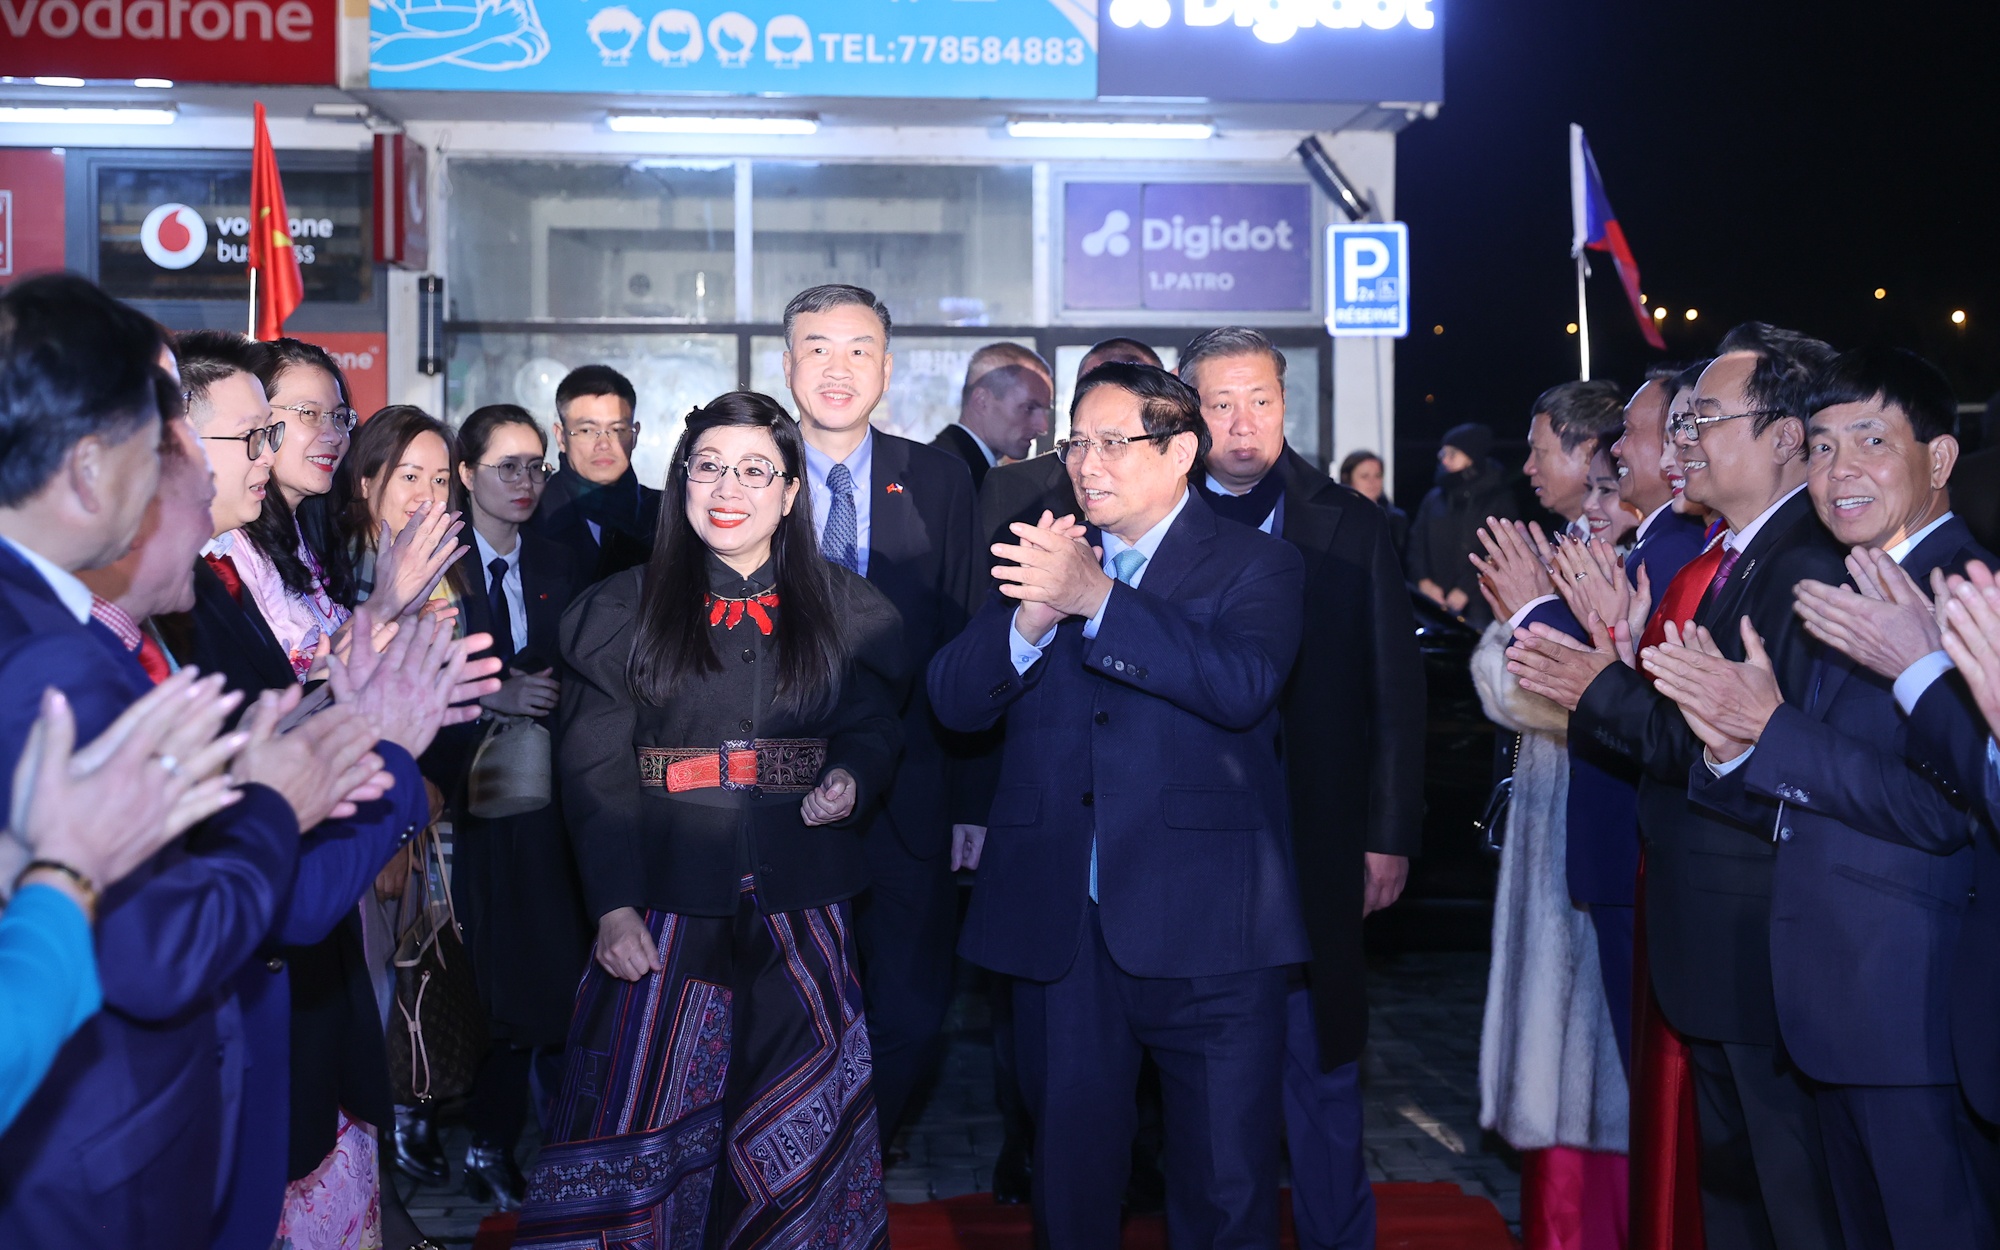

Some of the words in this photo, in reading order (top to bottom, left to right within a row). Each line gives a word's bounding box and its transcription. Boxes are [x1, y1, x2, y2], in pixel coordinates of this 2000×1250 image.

[818, 33, 1085, 66] TEL:778584883
[215, 216, 334, 239] voone
[1142, 214, 1294, 260] Digidot
[1150, 272, 1235, 292] 1.PATRO
[1343, 237, 1391, 303] P
[1335, 304, 1399, 325] RÉSERVÉ
